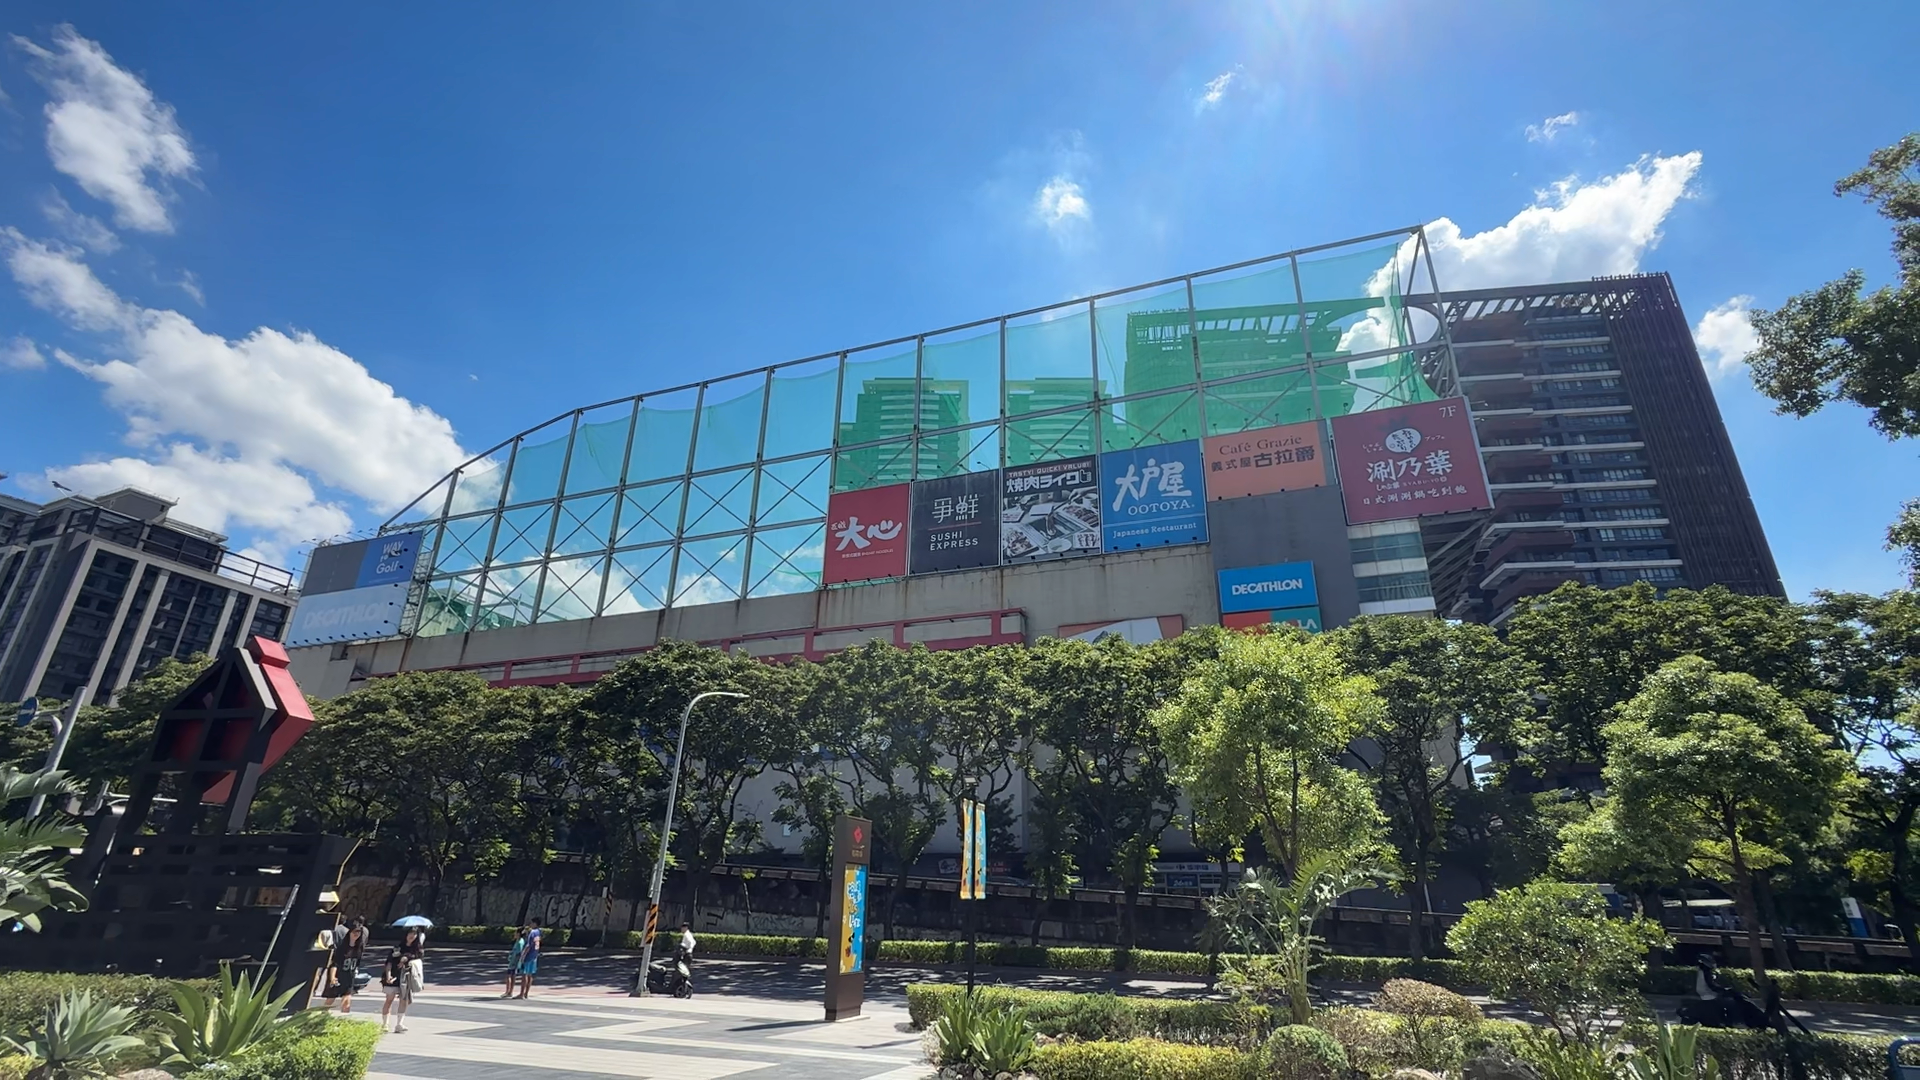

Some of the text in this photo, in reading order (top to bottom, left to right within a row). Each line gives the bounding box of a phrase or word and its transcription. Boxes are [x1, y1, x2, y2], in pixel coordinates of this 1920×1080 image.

[1439, 405, 1457, 418] 7F
[1219, 435, 1302, 456] Café Grazie
[1211, 445, 1315, 472] 義式屋古拉爵
[1366, 450, 1453, 483] 涮乃葉
[1363, 484, 1467, 505] 日式涮涮鍋吃到飽
[931, 493, 979, 523] 爭鮮
[1128, 499, 1190, 516] OOTOYA
[835, 516, 902, 551] 大心
[930, 531, 963, 542] SUSHI
[1113, 522, 1197, 538] Japanese Restaurant
[383, 541, 404, 553] WAY
[930, 538, 979, 551] EXPRESS
[376, 560, 399, 574] Golf
[1232, 578, 1303, 596] DECATHLON
